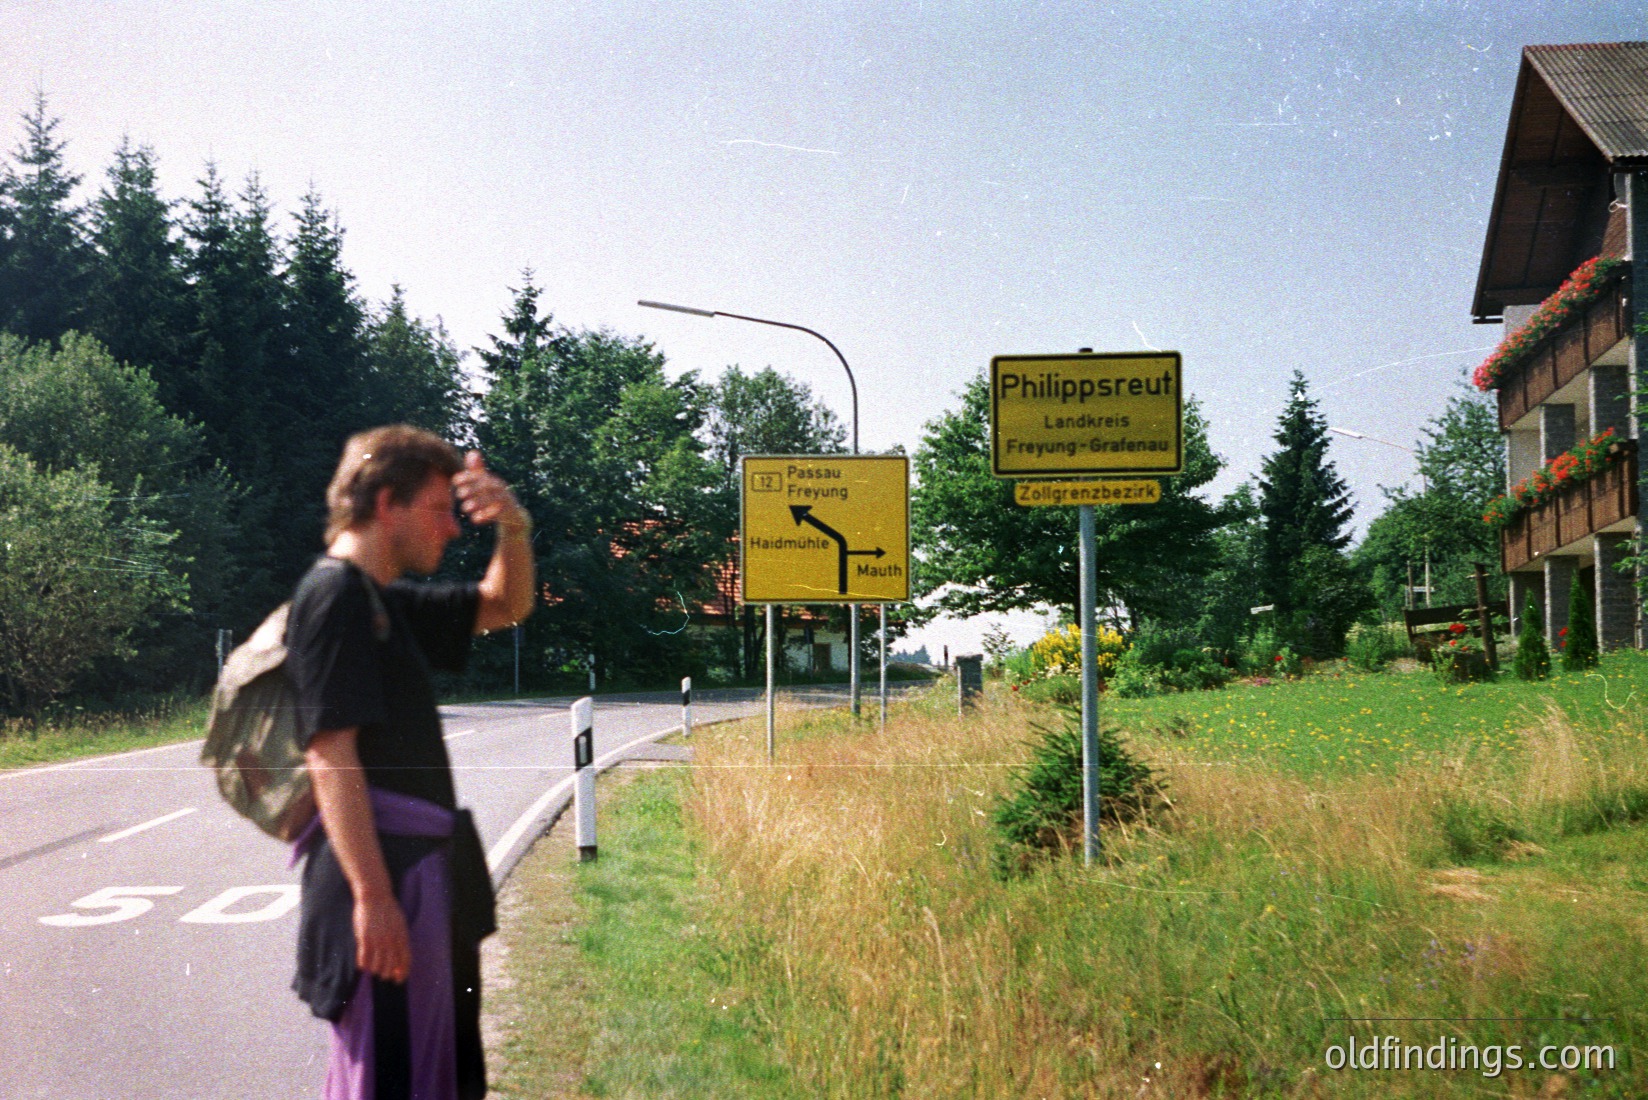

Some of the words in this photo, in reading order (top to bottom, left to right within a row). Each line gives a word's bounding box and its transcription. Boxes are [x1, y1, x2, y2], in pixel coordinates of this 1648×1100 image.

[1001, 370, 1172, 403] Philippsreut
[1044, 414, 1130, 429] Landkreis
[1006, 438, 1168, 457] Freyung-Grafenau
[787, 466, 841, 479] Passau
[760, 476, 773, 488] 12
[787, 485, 848, 500] Freyung
[1019, 484, 1155, 503] Zollgrenzbezirk
[857, 564, 902, 577] Mauth
